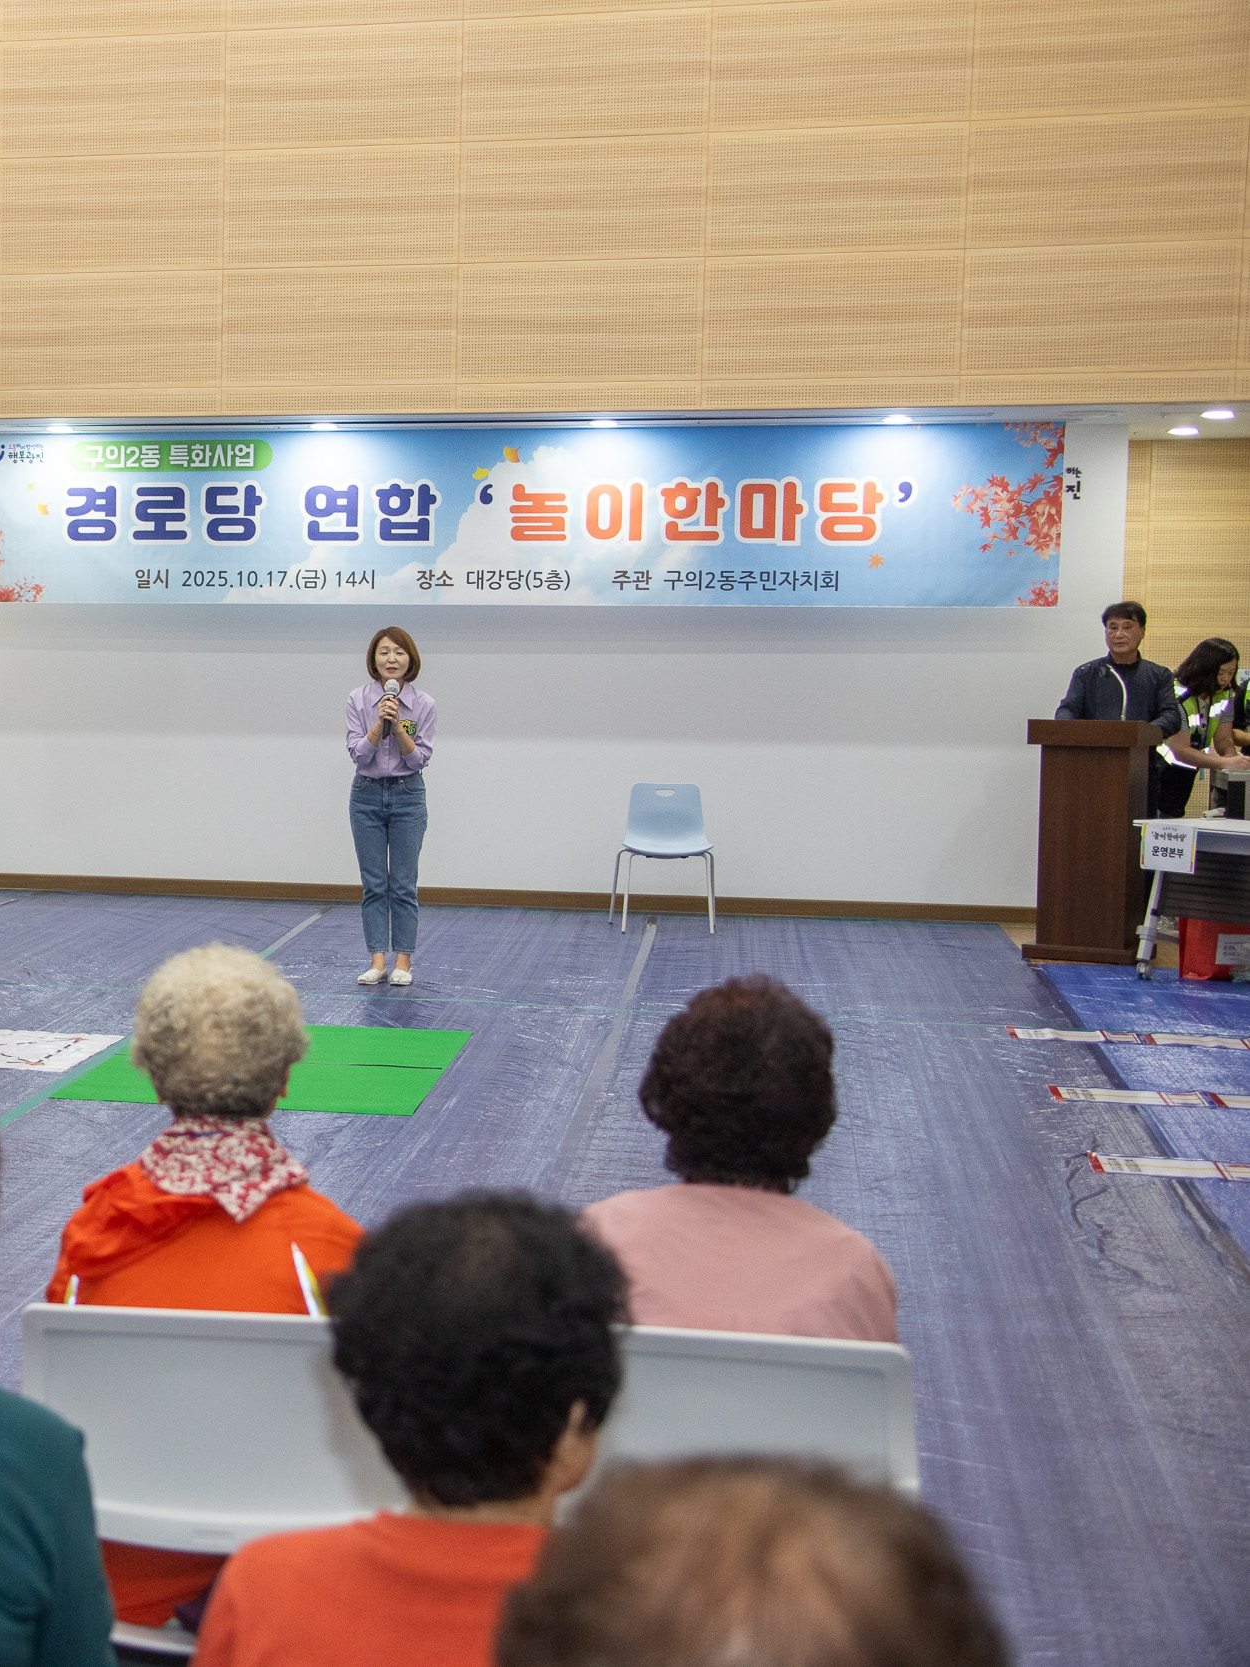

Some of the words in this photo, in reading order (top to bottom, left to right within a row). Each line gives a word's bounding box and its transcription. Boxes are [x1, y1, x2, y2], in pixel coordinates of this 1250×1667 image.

[8, 450, 44, 464] 행복광진
[83, 444, 161, 468] 구의2동
[169, 443, 255, 468] 특화사업
[65, 484, 263, 542] 경로당
[304, 483, 438, 542] 연합
[135, 568, 170, 590] 일시
[181, 568, 327, 590] 2025.10.17.(금)
[335, 569, 375, 590] 14시
[416, 569, 455, 590] 장소
[466, 569, 571, 591] 대강당(5층)
[611, 569, 653, 591] 주관
[663, 569, 840, 592] 구의2동주민자치회
[1151, 845, 1184, 859] 운영본부
